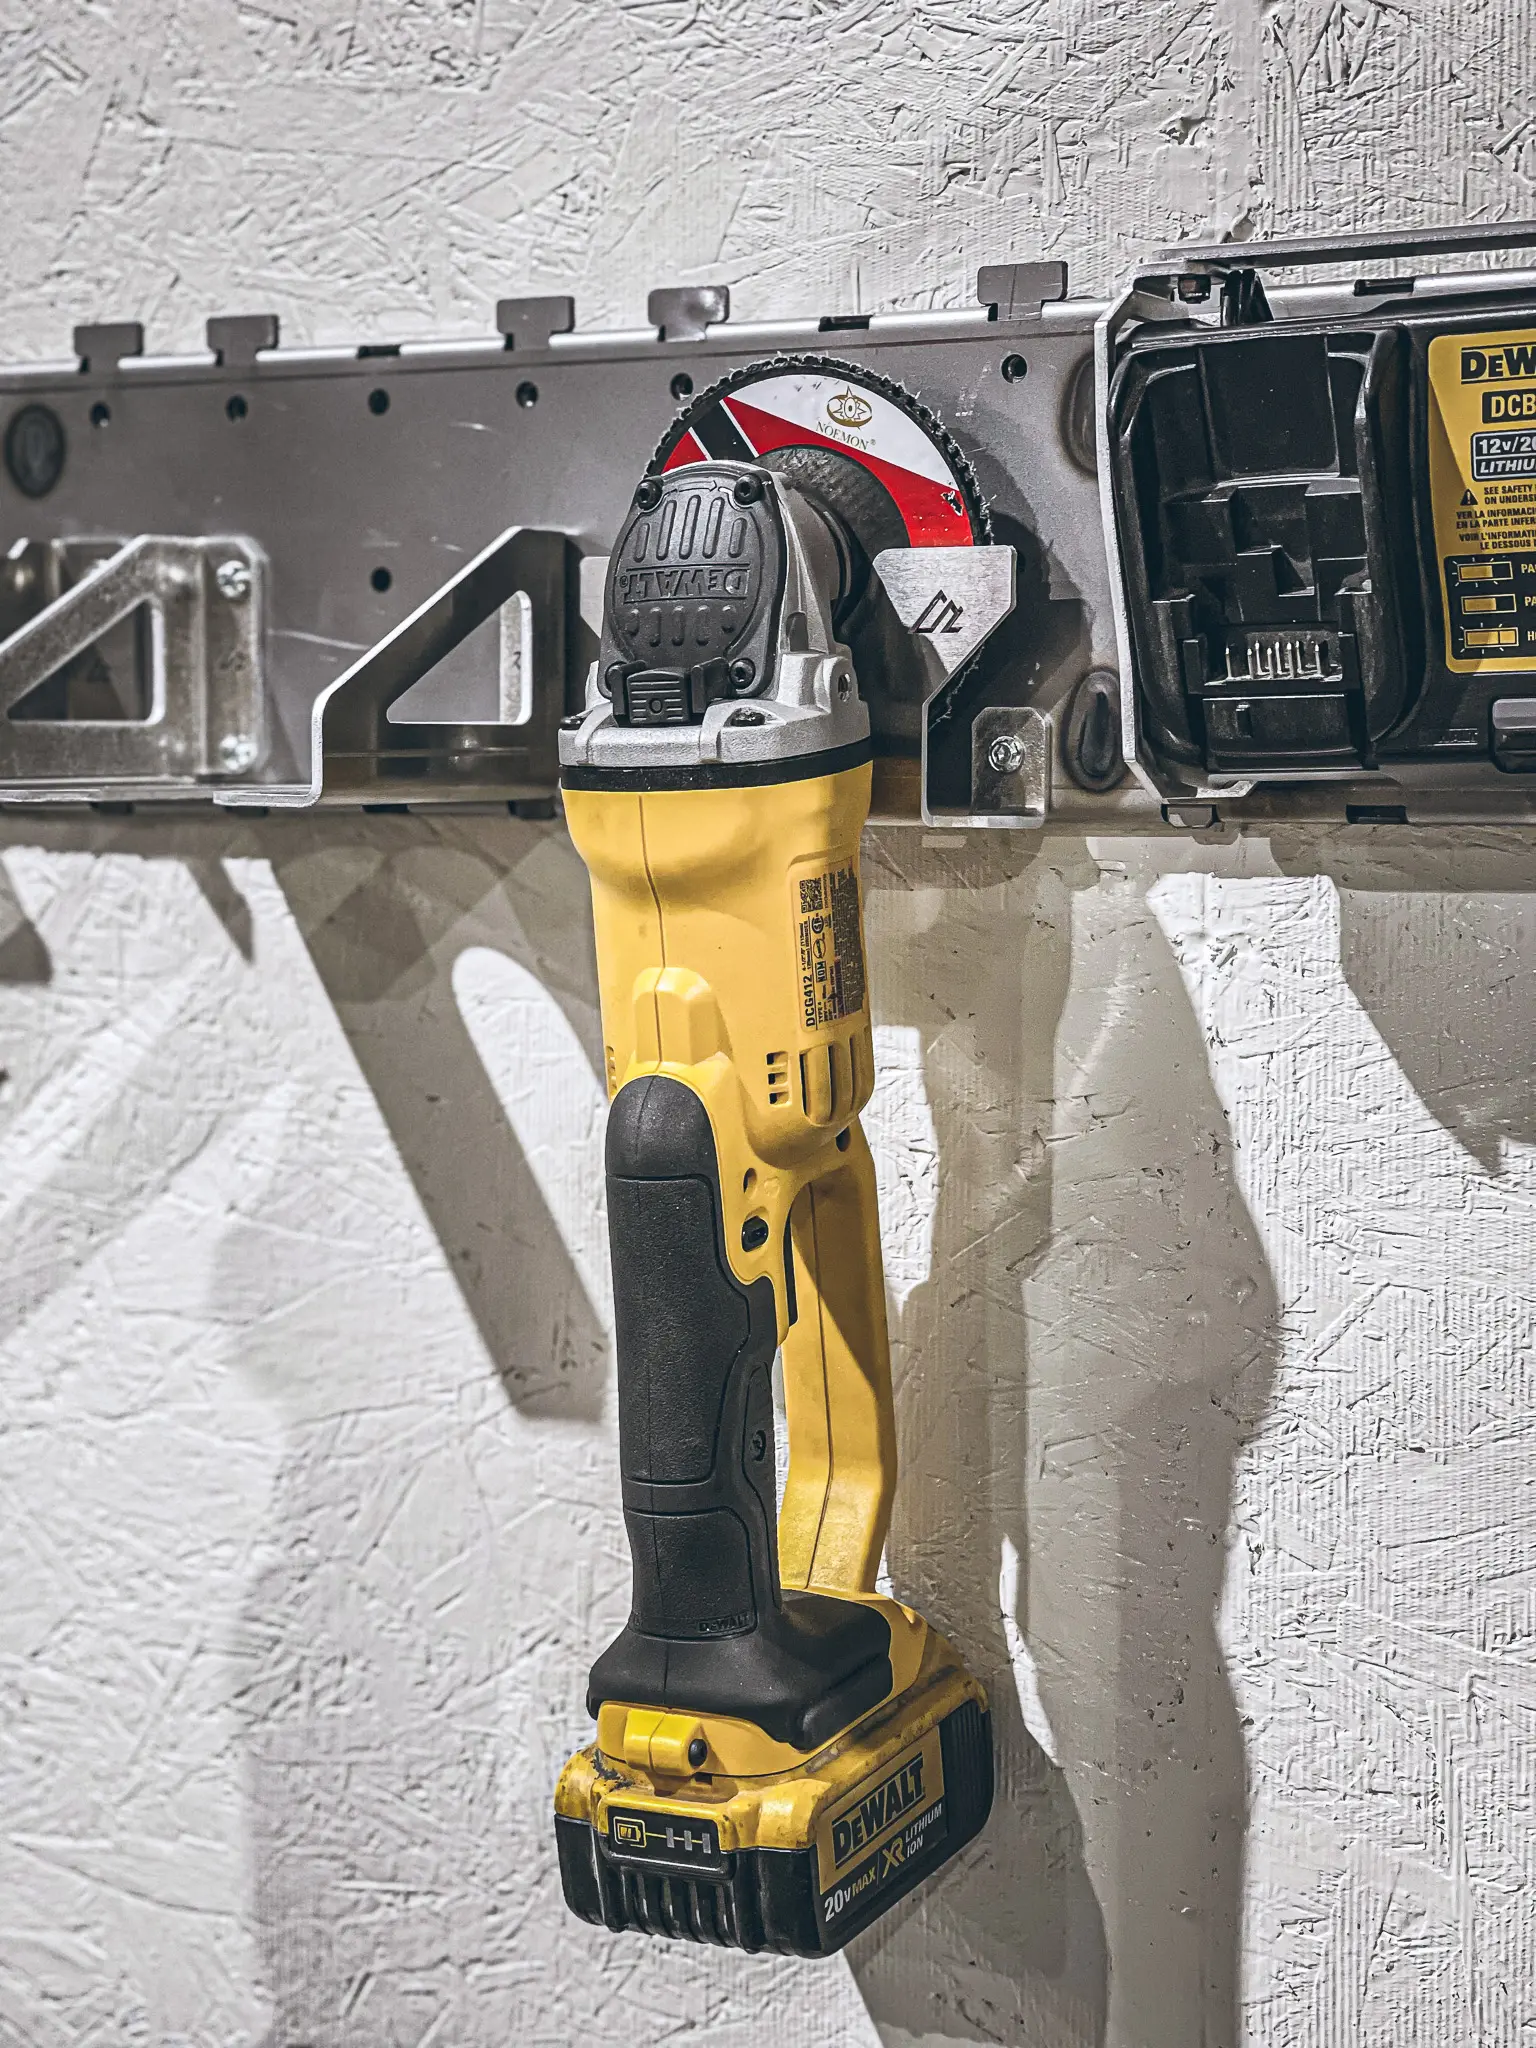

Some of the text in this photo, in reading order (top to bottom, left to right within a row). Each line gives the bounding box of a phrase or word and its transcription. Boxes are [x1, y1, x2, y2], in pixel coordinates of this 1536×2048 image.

[1490, 393, 1536, 418] DCB
[816, 421, 869, 451] NOEMON
[1480, 458, 1536, 474] LITHIU
[1483, 484, 1533, 495] SEE SAFETY
[1484, 494, 1536, 505] ON UNDERS
[1456, 507, 1536, 520] VER LA INFORMACI
[1456, 520, 1468, 529] EN
[1470, 519, 1481, 529] LA
[1482, 518, 1509, 528] PARTE
[1459, 529, 1536, 542] VOIR L'INFORMATI
[1480, 539, 1531, 550] LE DESSOUS
[1521, 563, 1536, 574] PA
[624, 568, 751, 600] DEWALT
[803, 974, 816, 1027] DCG412
[832, 1758, 924, 1864] DEWALT
[852, 1866, 876, 1897] MAX
[882, 1836, 905, 1879] XR
[905, 1803, 943, 1843] LITHIUM
[906, 1834, 924, 1858] ION
